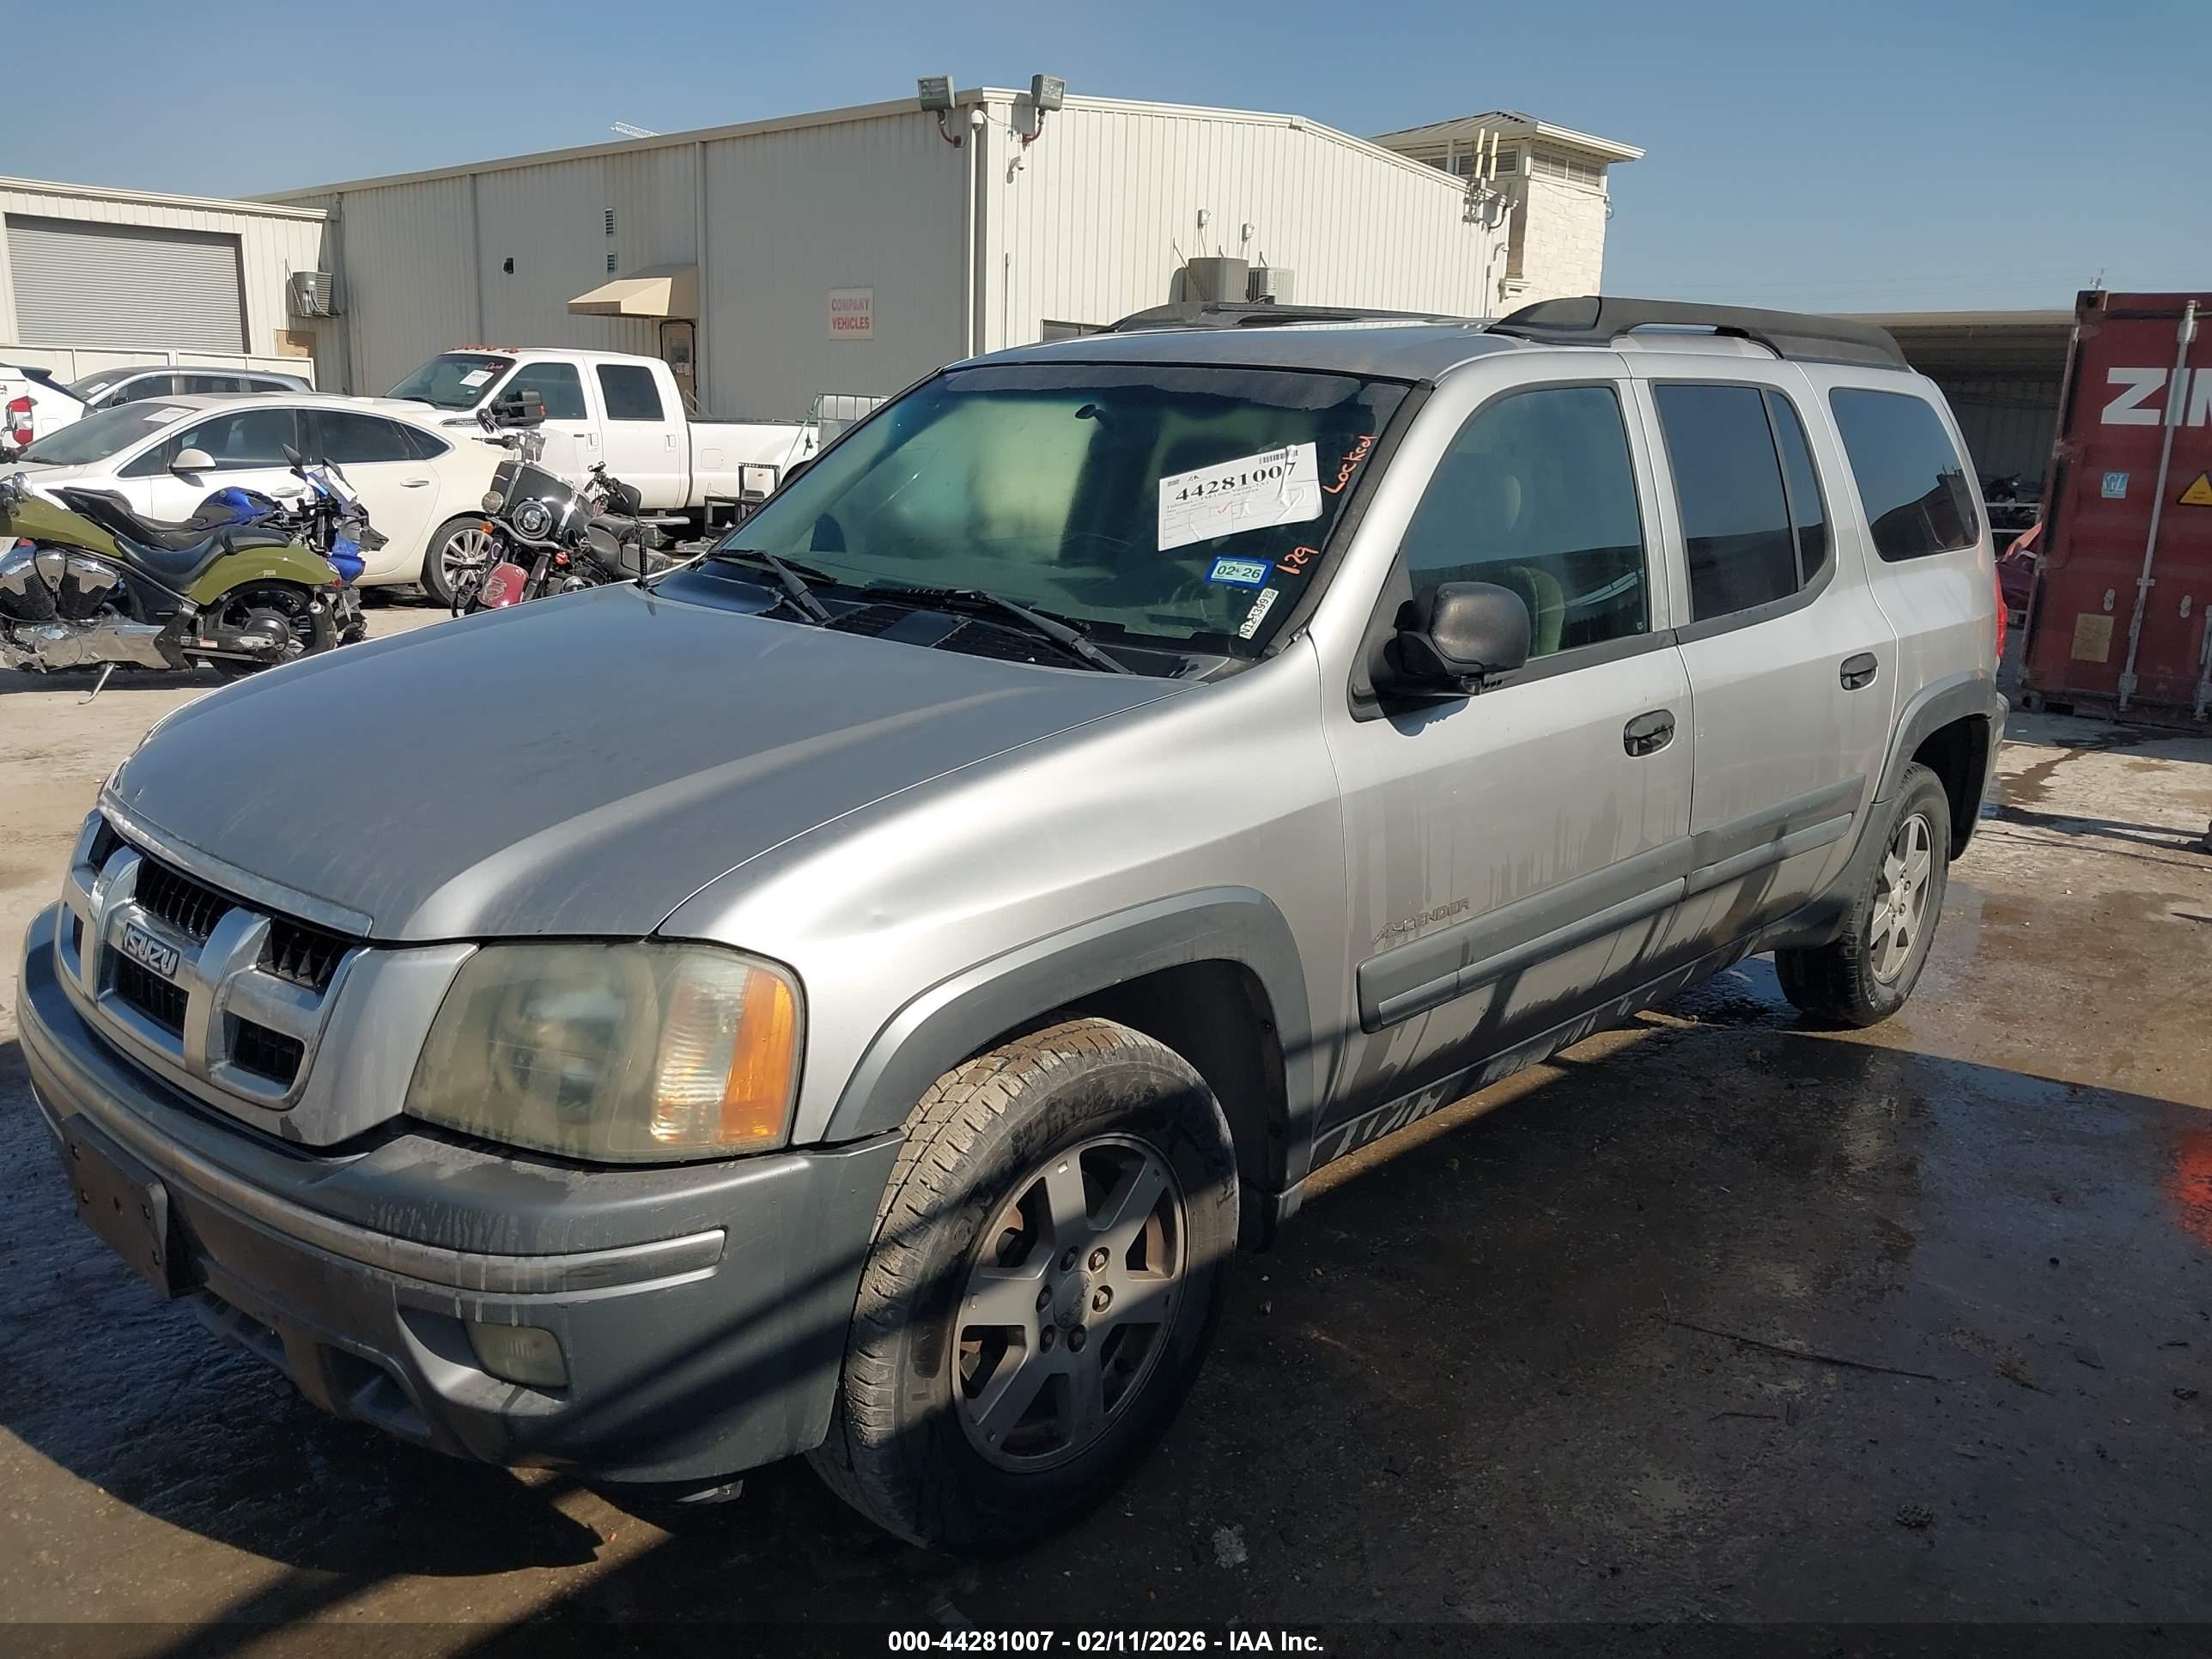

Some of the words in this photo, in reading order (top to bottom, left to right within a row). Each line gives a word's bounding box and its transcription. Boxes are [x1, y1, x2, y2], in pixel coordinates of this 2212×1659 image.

[831, 298, 870, 312] COMPANY
[831, 316, 870, 331] VEHICLES
[1176, 461, 1297, 501] 44281007
[1217, 565, 1236, 576] 02
[1242, 568, 1261, 579] 26
[1373, 896, 1470, 944] ASCENDER
[125, 927, 177, 975] ISUZU
